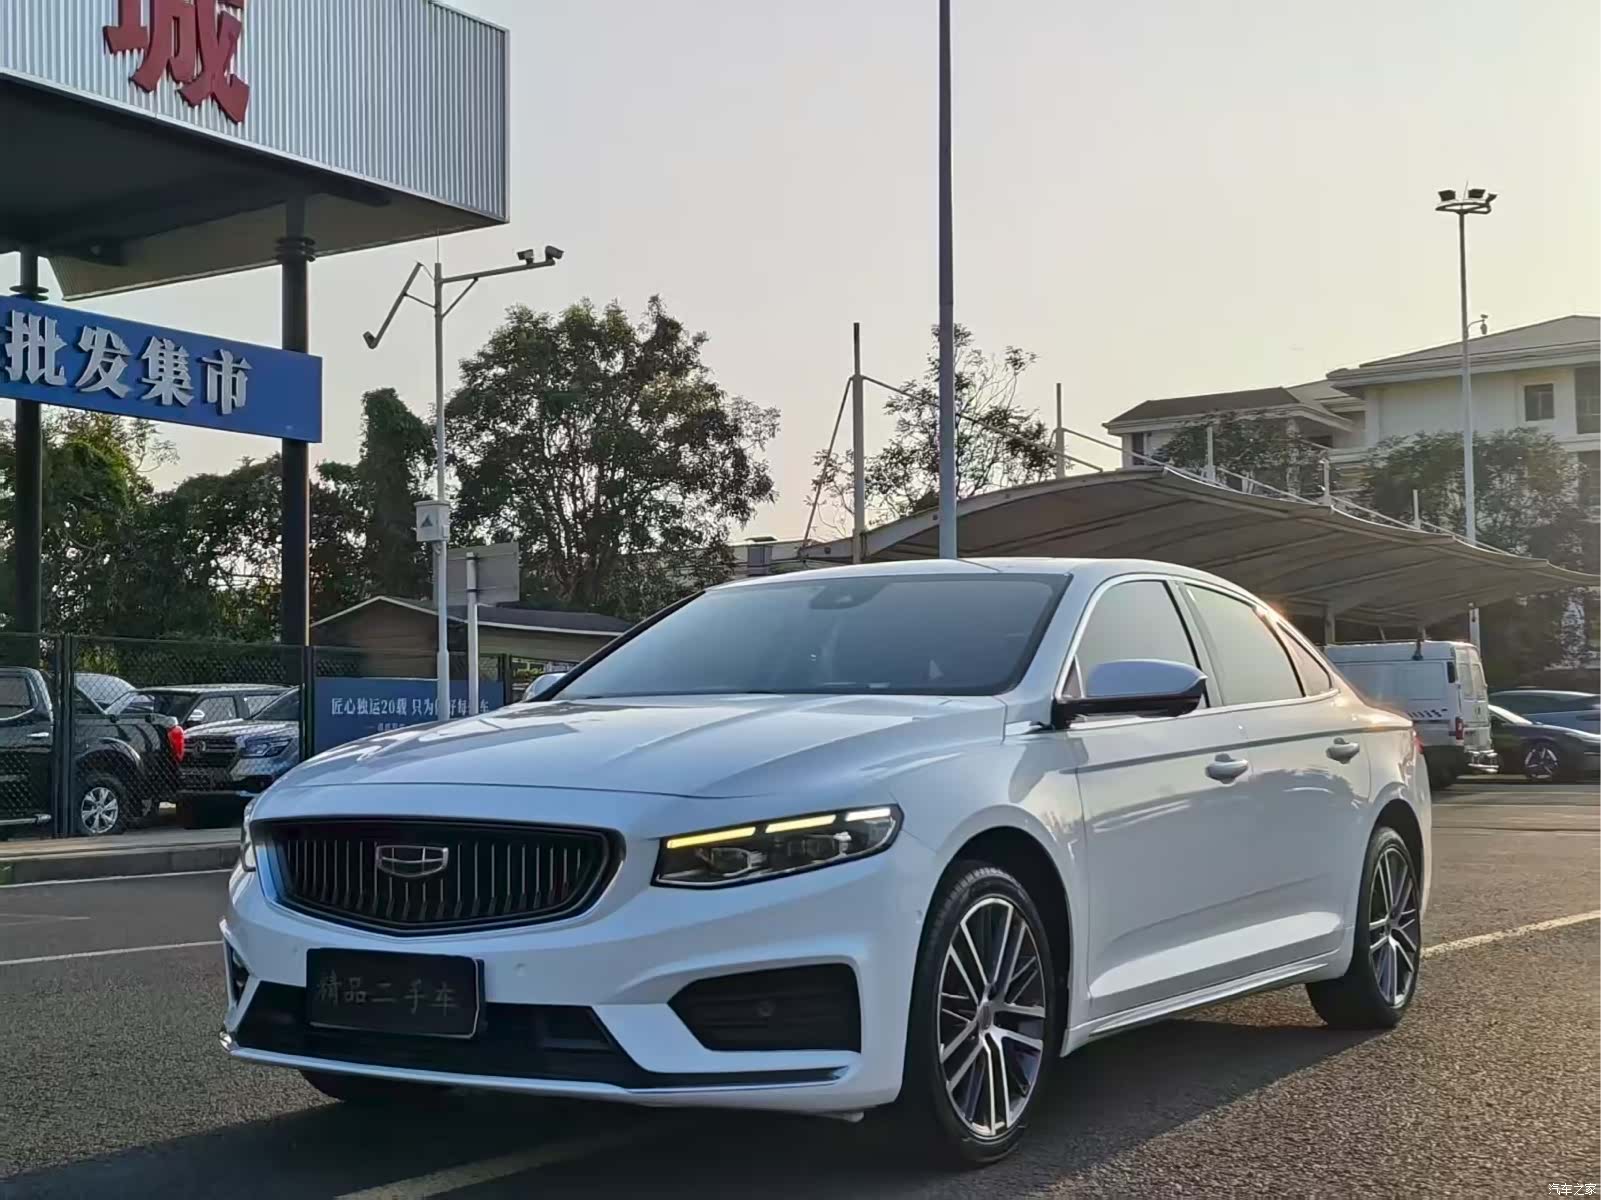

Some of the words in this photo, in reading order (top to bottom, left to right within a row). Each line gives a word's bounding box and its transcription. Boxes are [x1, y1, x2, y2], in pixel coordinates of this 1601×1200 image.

[102, 0, 250, 124] 城
[4, 309, 253, 416] 批发集市
[331, 697, 407, 716] 匠心独运20载
[316, 969, 459, 1016] 精品二手车
